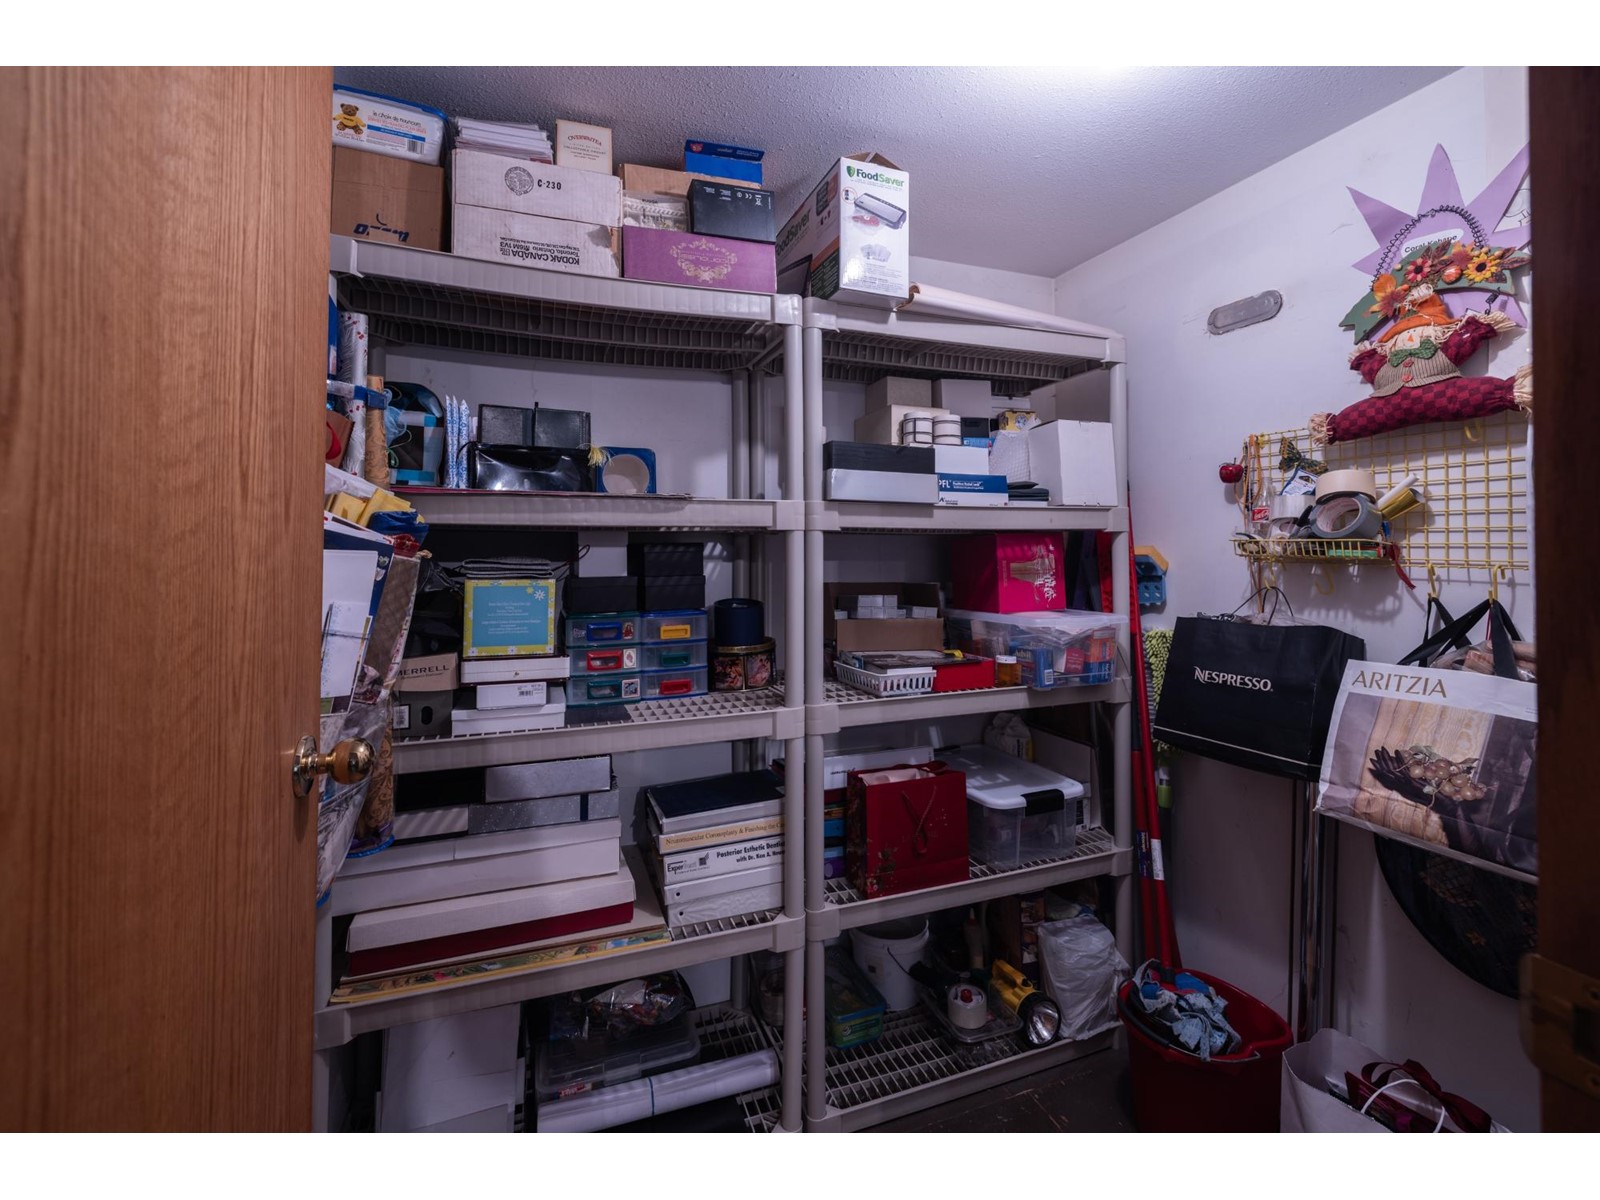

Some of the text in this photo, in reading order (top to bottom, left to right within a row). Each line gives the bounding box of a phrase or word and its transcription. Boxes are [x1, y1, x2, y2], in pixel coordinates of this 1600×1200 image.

[856, 168, 905, 188] FoodSaver
[537, 178, 562, 191] C-230
[511, 249, 549, 261] CANADA
[532, 246, 555, 255] Ontario
[555, 248, 580, 257] Toronto,
[550, 253, 580, 265] KODAK
[1193, 665, 1272, 692] NESPRESSO
[1351, 670, 1447, 698] ARITZIA
[716, 848, 743, 858] Posterior
[744, 843, 765, 854] Esthetic
[736, 855, 747, 863] with
